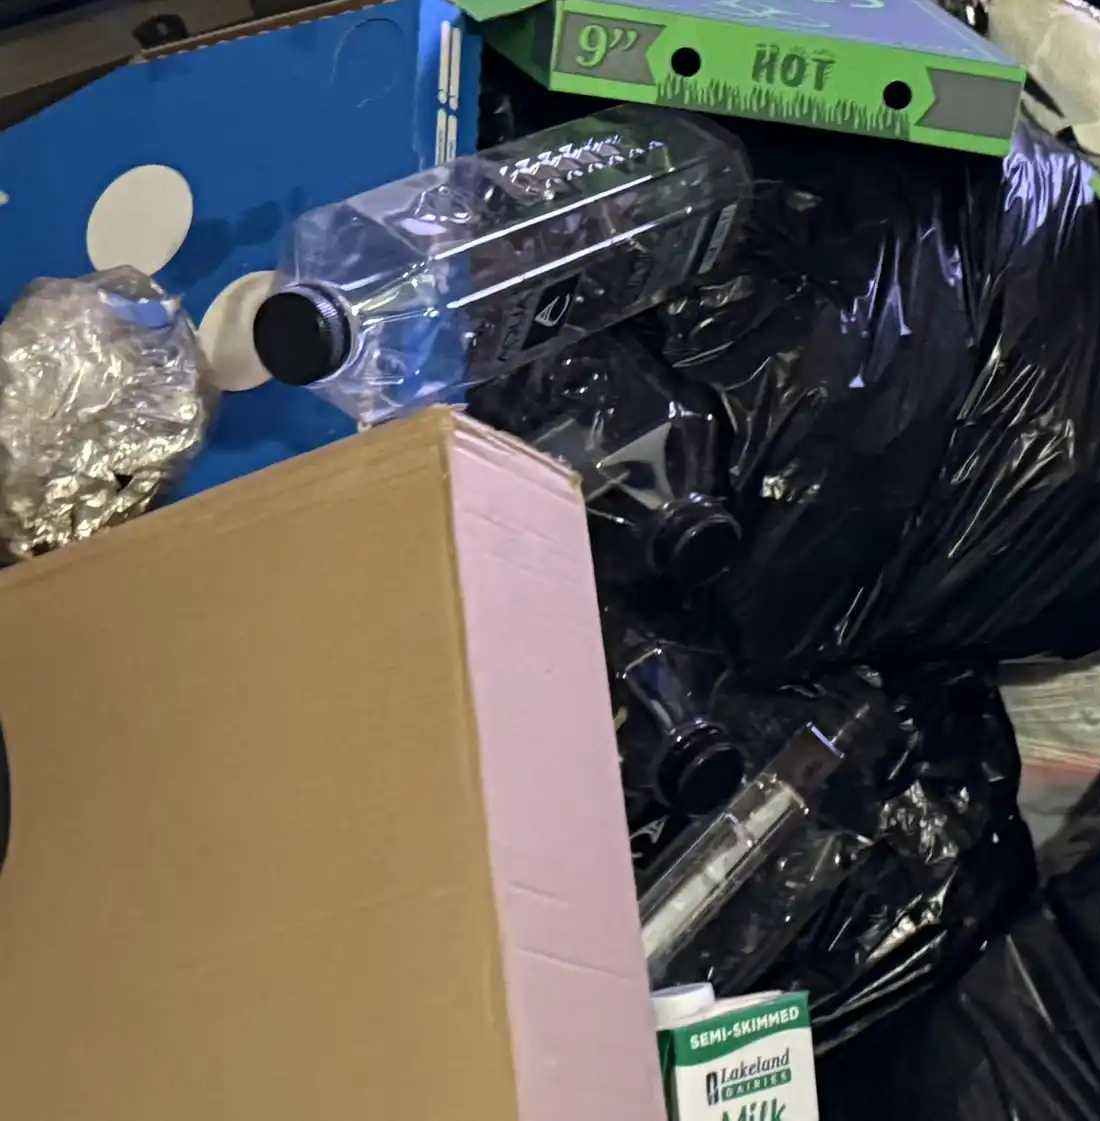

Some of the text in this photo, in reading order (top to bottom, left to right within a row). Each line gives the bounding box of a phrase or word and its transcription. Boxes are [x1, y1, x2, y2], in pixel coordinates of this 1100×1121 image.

[752, 42, 836, 92] HOT
[690, 1006, 800, 1050] SEMI-SKIMMED
[720, 1046, 790, 1084] Lakeland
[725, 1070, 788, 1097] DAIRIES
